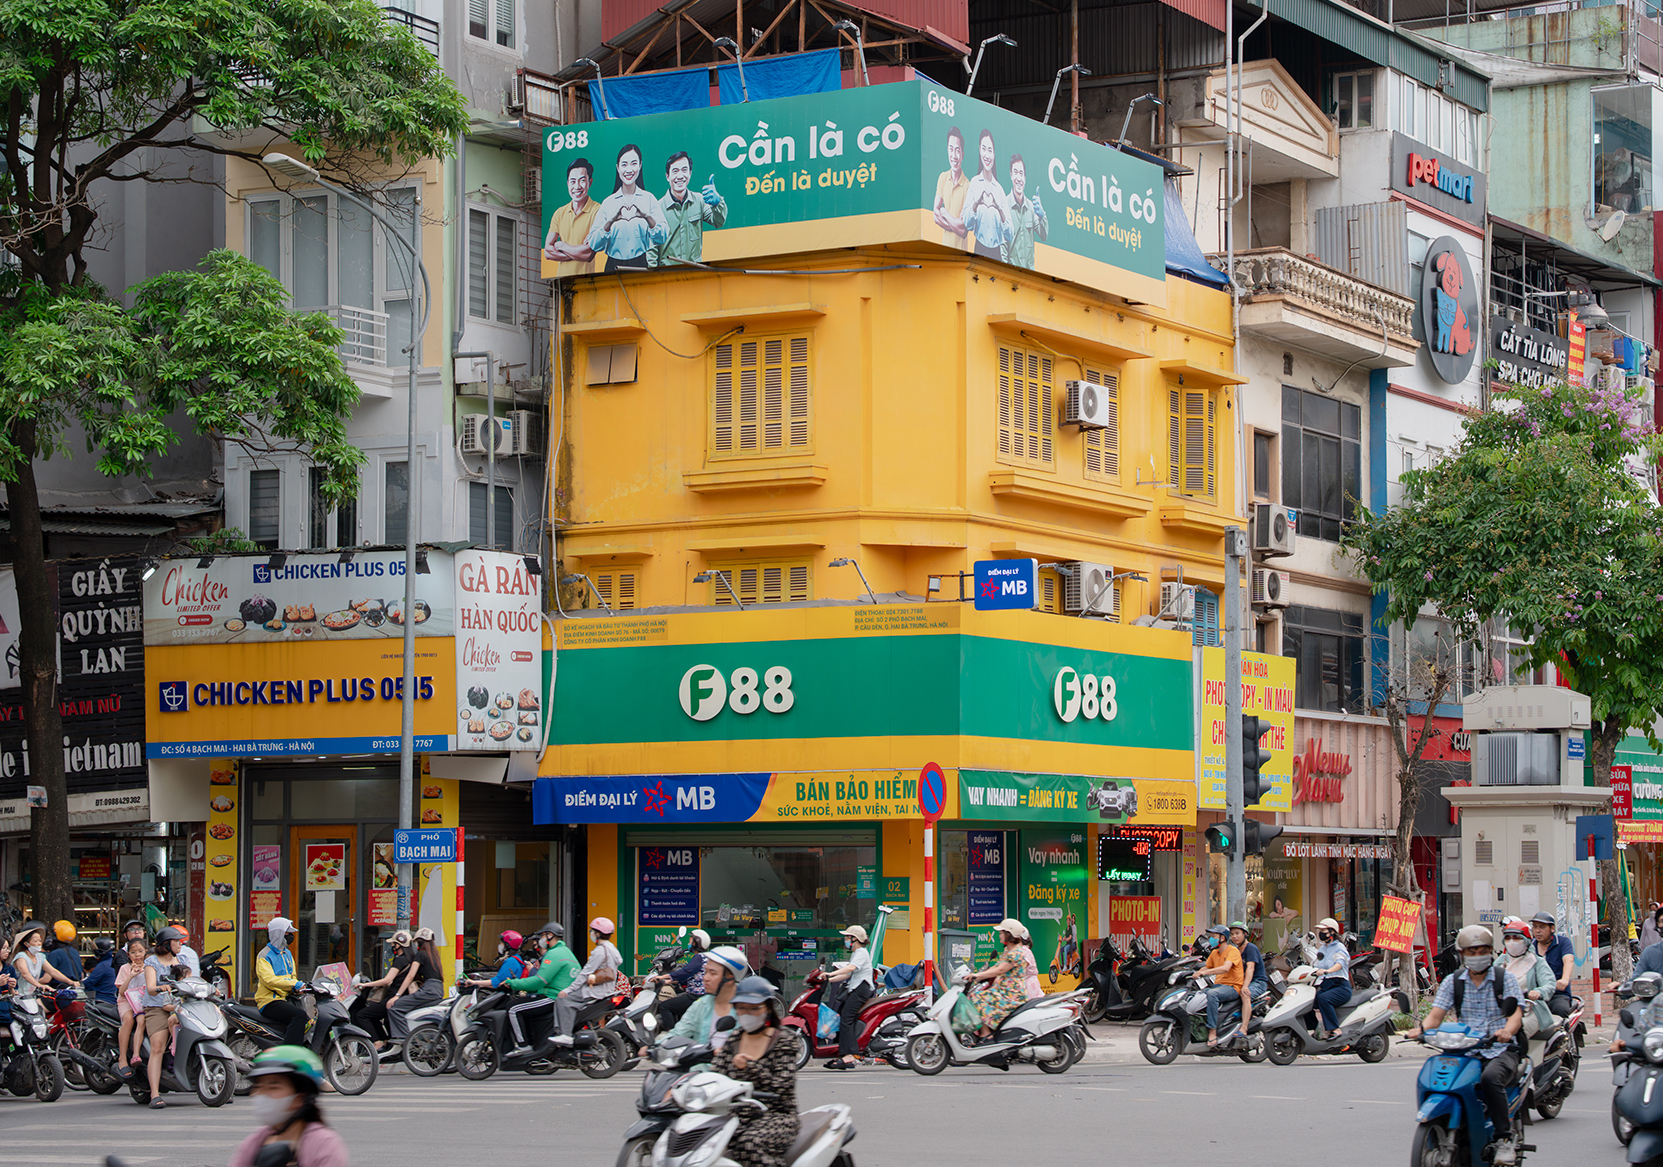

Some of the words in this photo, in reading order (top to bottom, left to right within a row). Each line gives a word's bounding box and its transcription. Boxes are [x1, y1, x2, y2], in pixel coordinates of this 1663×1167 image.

[928, 90, 955, 117] F88
[547, 131, 589, 152] F88
[718, 120, 795, 169] Cần
[810, 120, 844, 159] là
[857, 111, 905, 153] có
[745, 170, 785, 196] Đến
[792, 170, 812, 190] là
[819, 163, 878, 190] duyệt
[1048, 152, 1095, 204] Cần
[1102, 174, 1122, 214] là
[1129, 187, 1156, 224] có
[1409, 153, 1475, 204] petmart
[1066, 206, 1090, 232] Đến
[1093, 215, 1106, 236] là
[1108, 222, 1142, 252] duyệt
[1500, 324, 1522, 355] CẮT
[1540, 342, 1566, 367] LÔNG
[1498, 360, 1518, 383] SPA
[274, 563, 340, 581] CHICKEN
[345, 561, 384, 578] PLUS
[459, 556, 490, 593] GÀ
[495, 559, 537, 596] RÁN
[161, 566, 228, 607] Chicken
[1002, 580, 1028, 596] MB
[62, 602, 142, 643] QUỲNH
[461, 603, 493, 630] HÀN
[497, 603, 538, 634] QUỐC
[80, 646, 126, 674] LAN
[463, 636, 500, 668] Chicken
[1254, 658, 1269, 679] HÒA
[193, 680, 304, 706] CHICKEN
[309, 677, 377, 703] PLUS
[679, 664, 794, 721] F88
[1054, 665, 1118, 723] F88
[1264, 686, 1273, 711] IN
[1275, 682, 1293, 714] MÀU
[97, 693, 121, 713] NỮ
[63, 736, 142, 773] ietnam
[175, 744, 185, 753] SỐ
[192, 745, 212, 755] BẠCH
[214, 744, 228, 753] MAI
[233, 744, 246, 752] HAI
[247, 742, 257, 752] BÀ
[258, 742, 283, 752] TRƯNG
[289, 741, 300, 751] HÀ
[301, 741, 315, 752] NỘI
[386, 740, 400, 748] 033
[415, 739, 433, 747] 7767
[796, 778, 829, 801] BÁN
[836, 774, 868, 801] BẢO
[875, 772, 917, 800] HIỂM
[968, 786, 985, 805] VAY
[987, 787, 1018, 807] NHANH
[1028, 786, 1052, 808] ĐĂNG
[1054, 787, 1065, 808] KÝ
[1067, 791, 1078, 808] XE
[1611, 782, 1630, 791] HỮA
[565, 790, 596, 806] ĐIỂM
[599, 793, 621, 809] ĐẠI
[624, 790, 638, 806] LÝ
[676, 786, 716, 811] MB
[777, 804, 798, 816] SỨC
[837, 801, 861, 815] NẰM
[865, 802, 891, 817] VIỆN,
[895, 804, 908, 814] TAI
[1153, 798, 1169, 810] 1800
[1171, 798, 1187, 810] 638
[1613, 796, 1625, 804] XE
[400, 846, 427, 860] BẠCH
[430, 846, 451, 858] MAI
[667, 850, 693, 865] MB
[985, 849, 1000, 864] MB
[1028, 847, 1047, 867] Vay
[1050, 848, 1080, 864] nhanh
[888, 881, 901, 892] 02
[1028, 884, 1053, 904] Đăng
[1056, 884, 1067, 903] ký
[1069, 889, 1080, 900] xe
[1382, 897, 1402, 914] PHOTO
[1403, 902, 1421, 917] COPY
[1378, 916, 1399, 937] CHỤP
[1399, 916, 1416, 938] ẢNH
[1379, 937, 1390, 947] LẤY
[1391, 941, 1406, 950] NGAY
